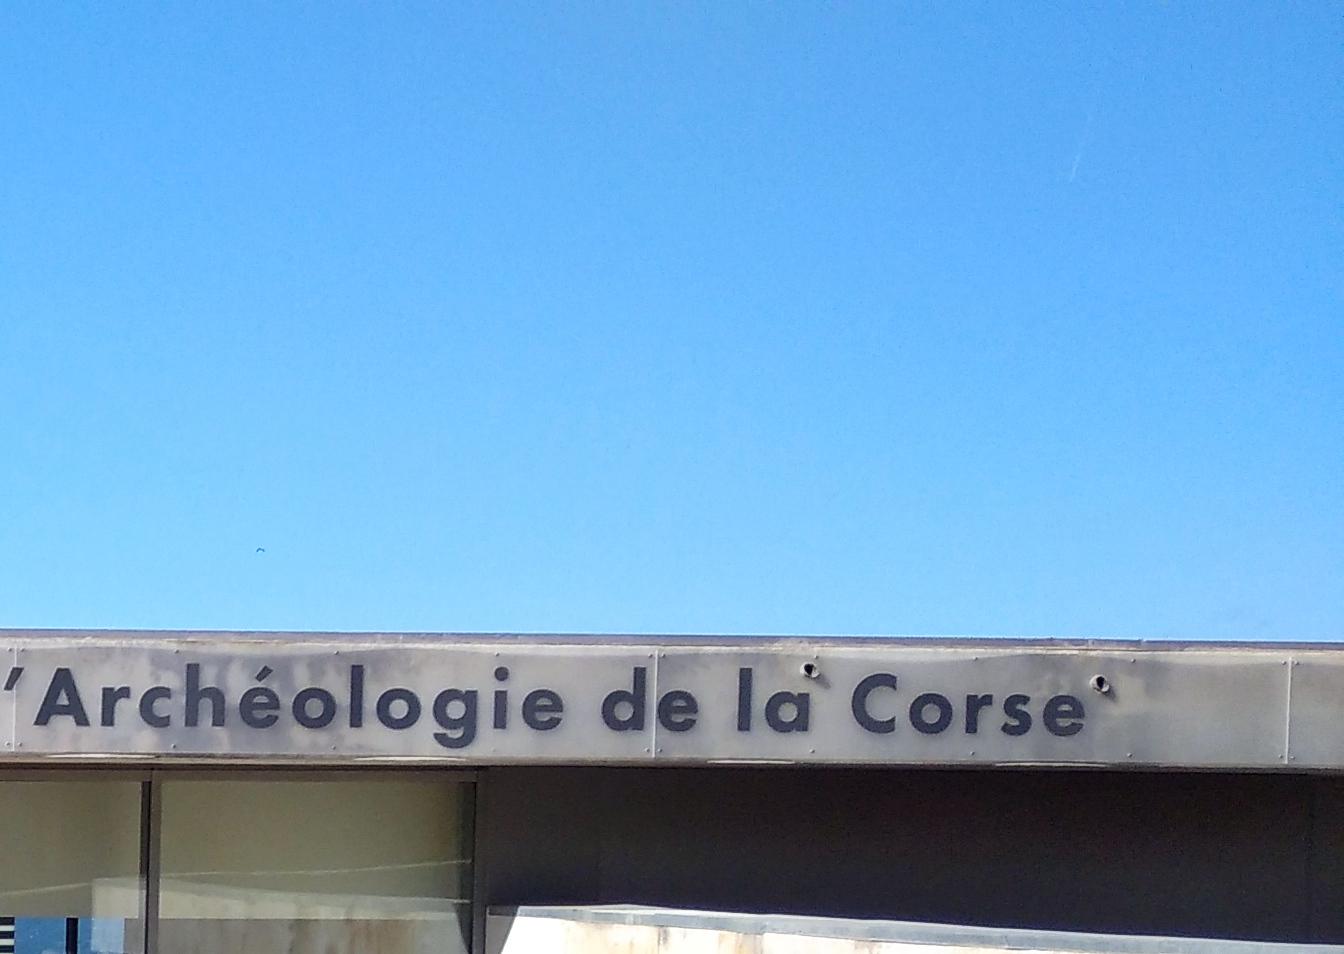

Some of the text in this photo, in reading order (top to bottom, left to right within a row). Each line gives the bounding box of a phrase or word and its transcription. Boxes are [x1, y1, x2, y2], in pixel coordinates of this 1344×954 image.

[601, 666, 700, 734] de
[737, 667, 811, 734] la
[851, 673, 1088, 738] Corse
